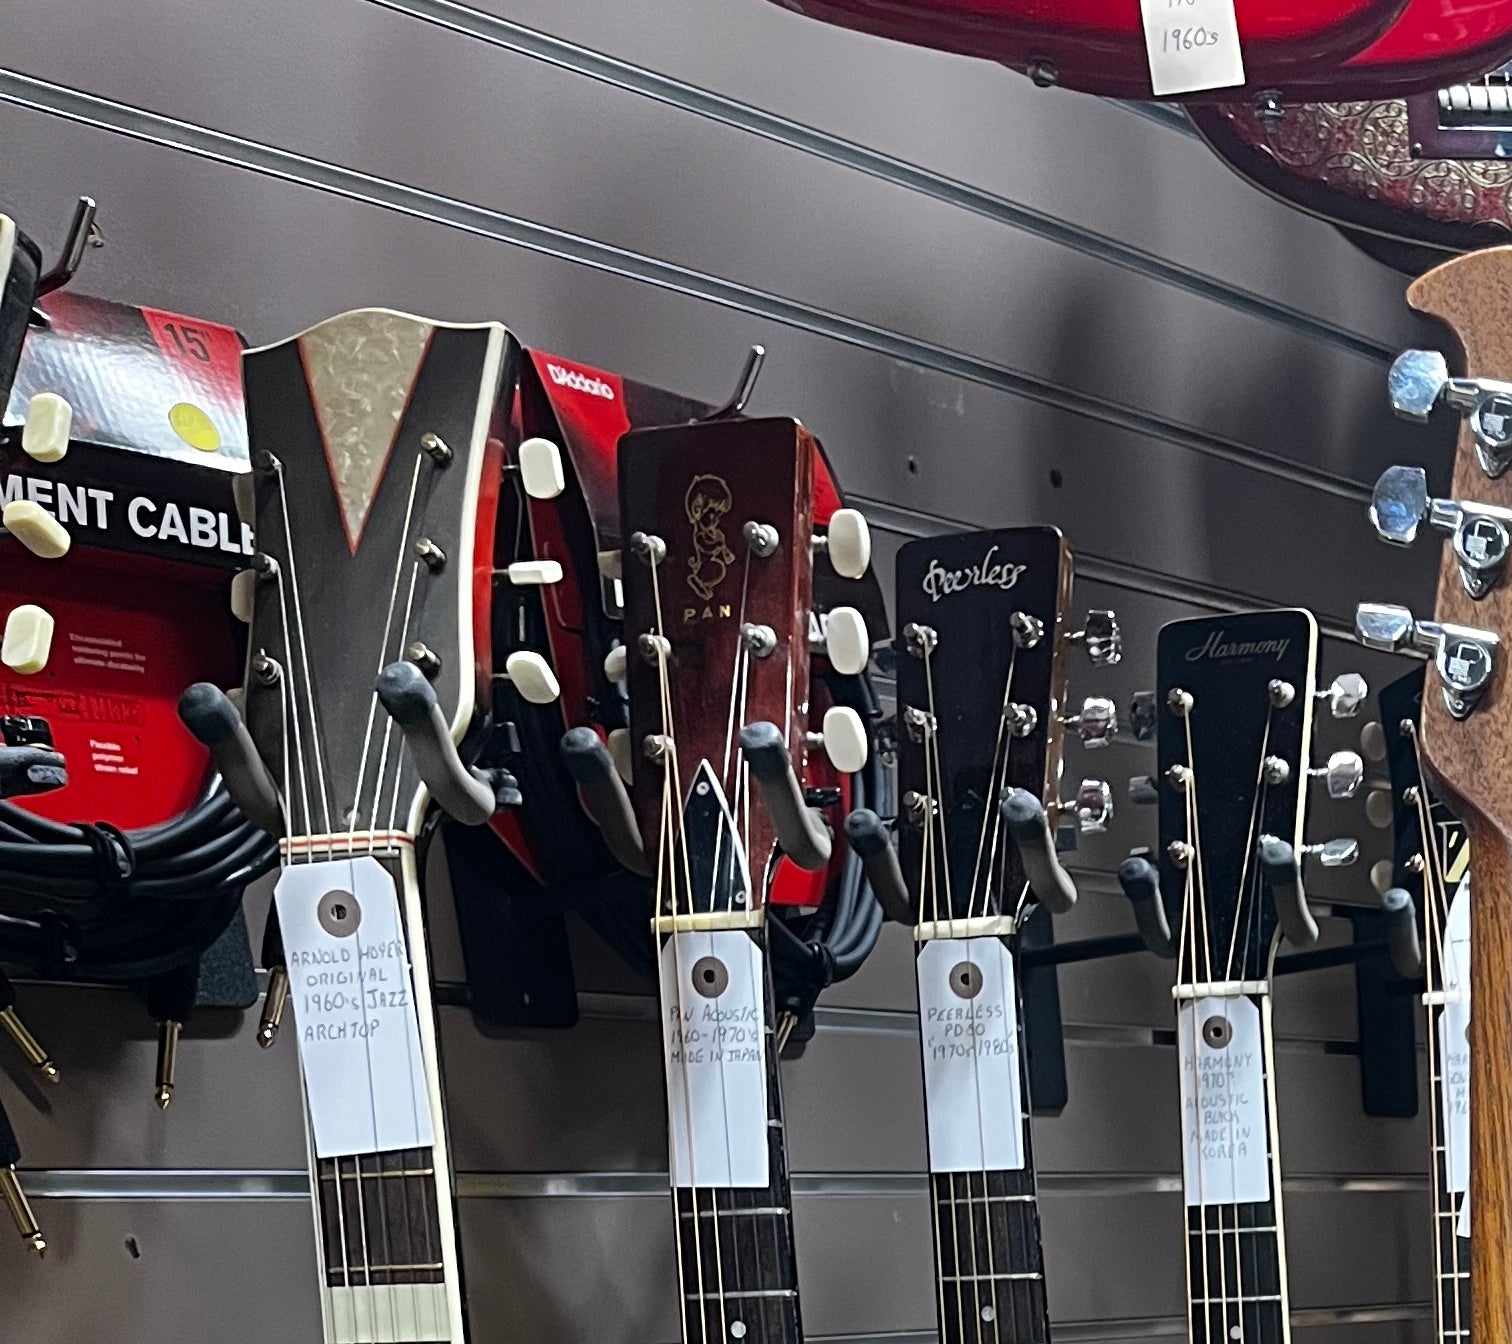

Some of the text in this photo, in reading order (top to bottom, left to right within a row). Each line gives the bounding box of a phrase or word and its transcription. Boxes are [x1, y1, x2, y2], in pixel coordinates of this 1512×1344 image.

[922, 545, 1027, 602] Peerless
[684, 604, 731, 622] PAN
[1185, 631, 1290, 661] Harmony
[291, 940, 404, 967] ARNOLD HOYER
[306, 967, 388, 987] ORIGINAL
[366, 989, 409, 1009] JAZZ
[670, 1006, 695, 1021] PN
[927, 1004, 1003, 1021] PEERLESS
[1185, 1093, 1249, 1111] AOUSTIC
[1236, 1126, 1251, 1140] IN
